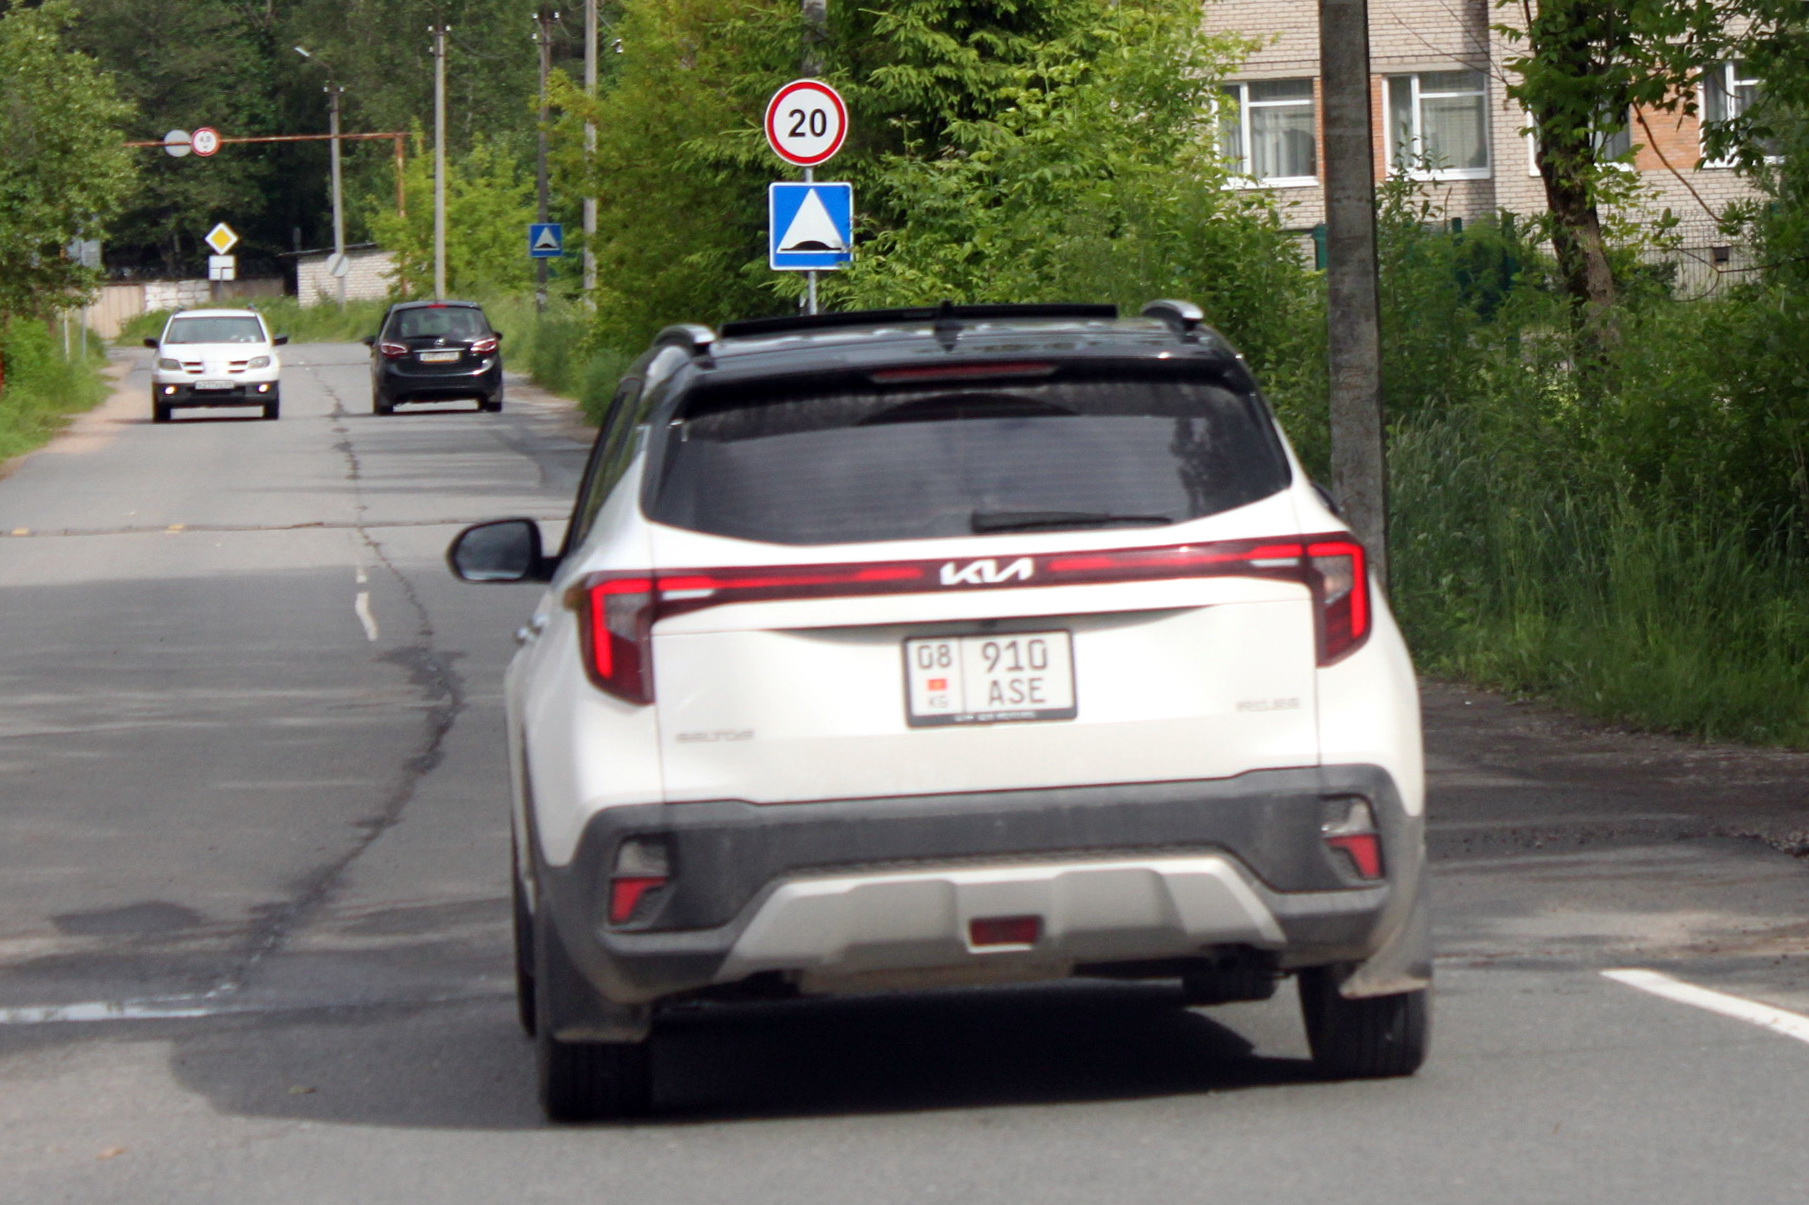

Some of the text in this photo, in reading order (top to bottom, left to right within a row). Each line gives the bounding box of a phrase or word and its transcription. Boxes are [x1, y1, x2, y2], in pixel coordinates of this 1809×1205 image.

[788, 109, 827, 137] 20
[940, 557, 1034, 585] KIA
[917, 639, 1048, 673] 08 910
[988, 677, 1046, 706] ASE
